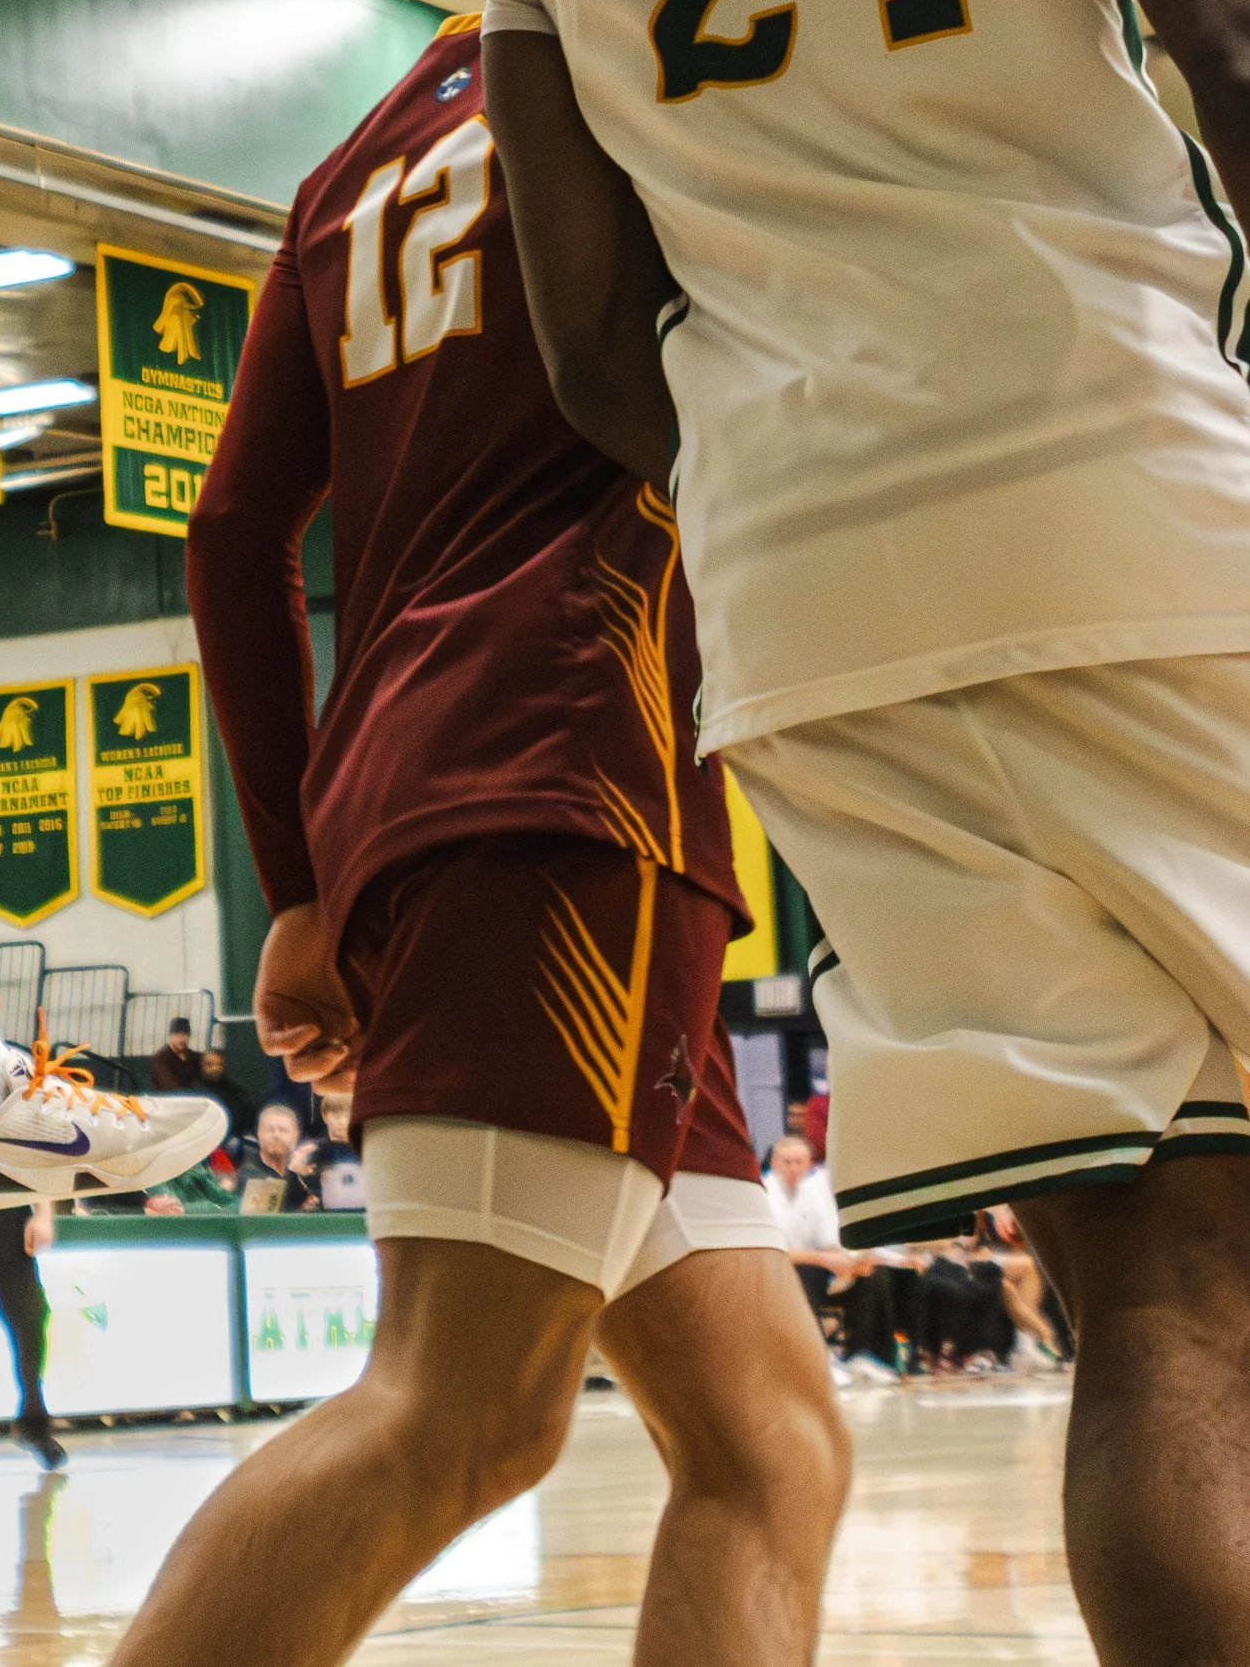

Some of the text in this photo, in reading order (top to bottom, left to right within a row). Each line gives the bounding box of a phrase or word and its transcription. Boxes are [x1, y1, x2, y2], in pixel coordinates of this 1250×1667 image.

[340, 113, 496, 390] 12
[141, 366, 224, 400] GYMNASTICS
[122, 389, 226, 428] NCGA NATION
[123, 415, 216, 456] CHAMPIO
[2, 777, 40, 795] NCAA
[98, 779, 191, 803] TOP FINISHES
[124, 765, 164, 783] NCAA
